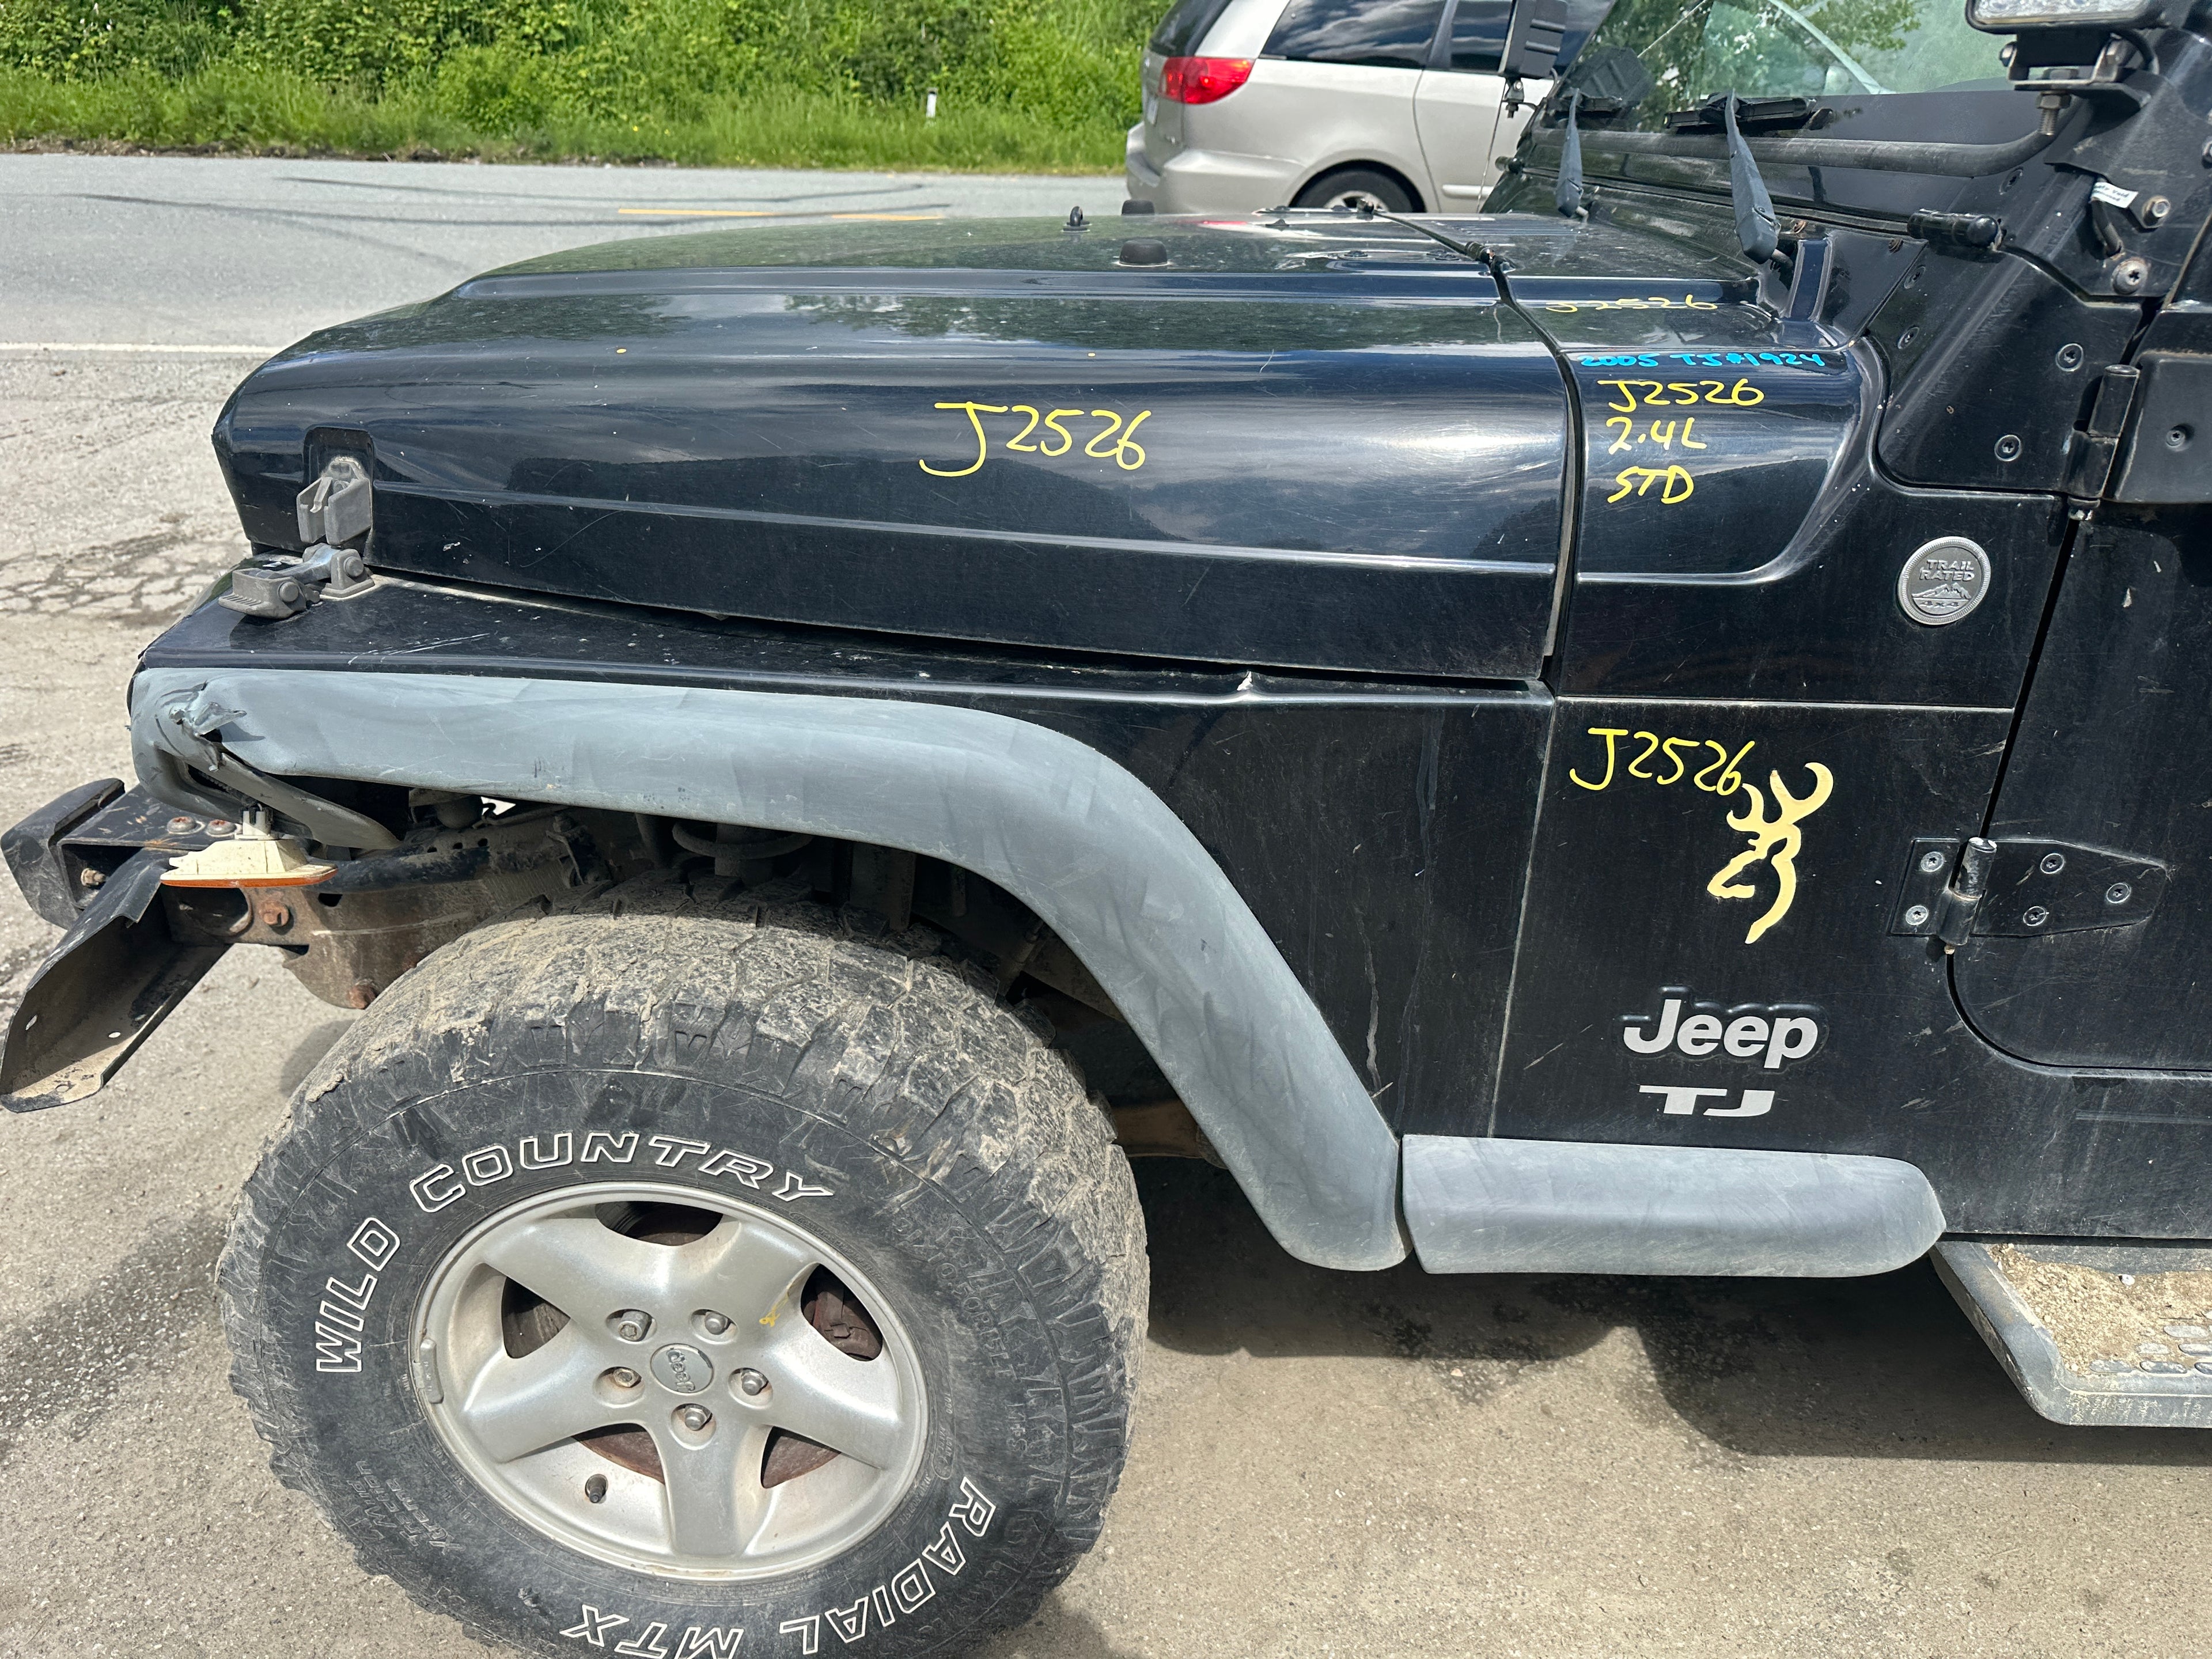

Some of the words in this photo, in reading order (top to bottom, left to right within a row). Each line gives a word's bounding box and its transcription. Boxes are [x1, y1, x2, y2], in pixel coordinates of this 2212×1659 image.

[1546, 294, 1717, 312] J2526
[1581, 353, 1659, 367] 2005
[1597, 378, 1764, 412] J2526
[919, 401, 1151, 477] J2526
[1606, 416, 1707, 454] 2.4L
[1607, 465, 1694, 504] STD
[1919, 568, 1975, 582] RATED
[1926, 559, 1975, 571] TRAIL
[1569, 727, 1756, 796] J2526
[1623, 999, 1818, 1069] Jeep
[1639, 1085, 1775, 1118] TJ
[316, 1217, 401, 1373] WILD
[410, 1131, 834, 1213] COUNTRY
[666, 1348, 695, 1392] Jeep
[355, 1460, 424, 1547] Traction
[385, 1477, 465, 1555] Xtreme
[779, 1476, 997, 1655] RADIAL
[558, 1604, 745, 1659] MTX
